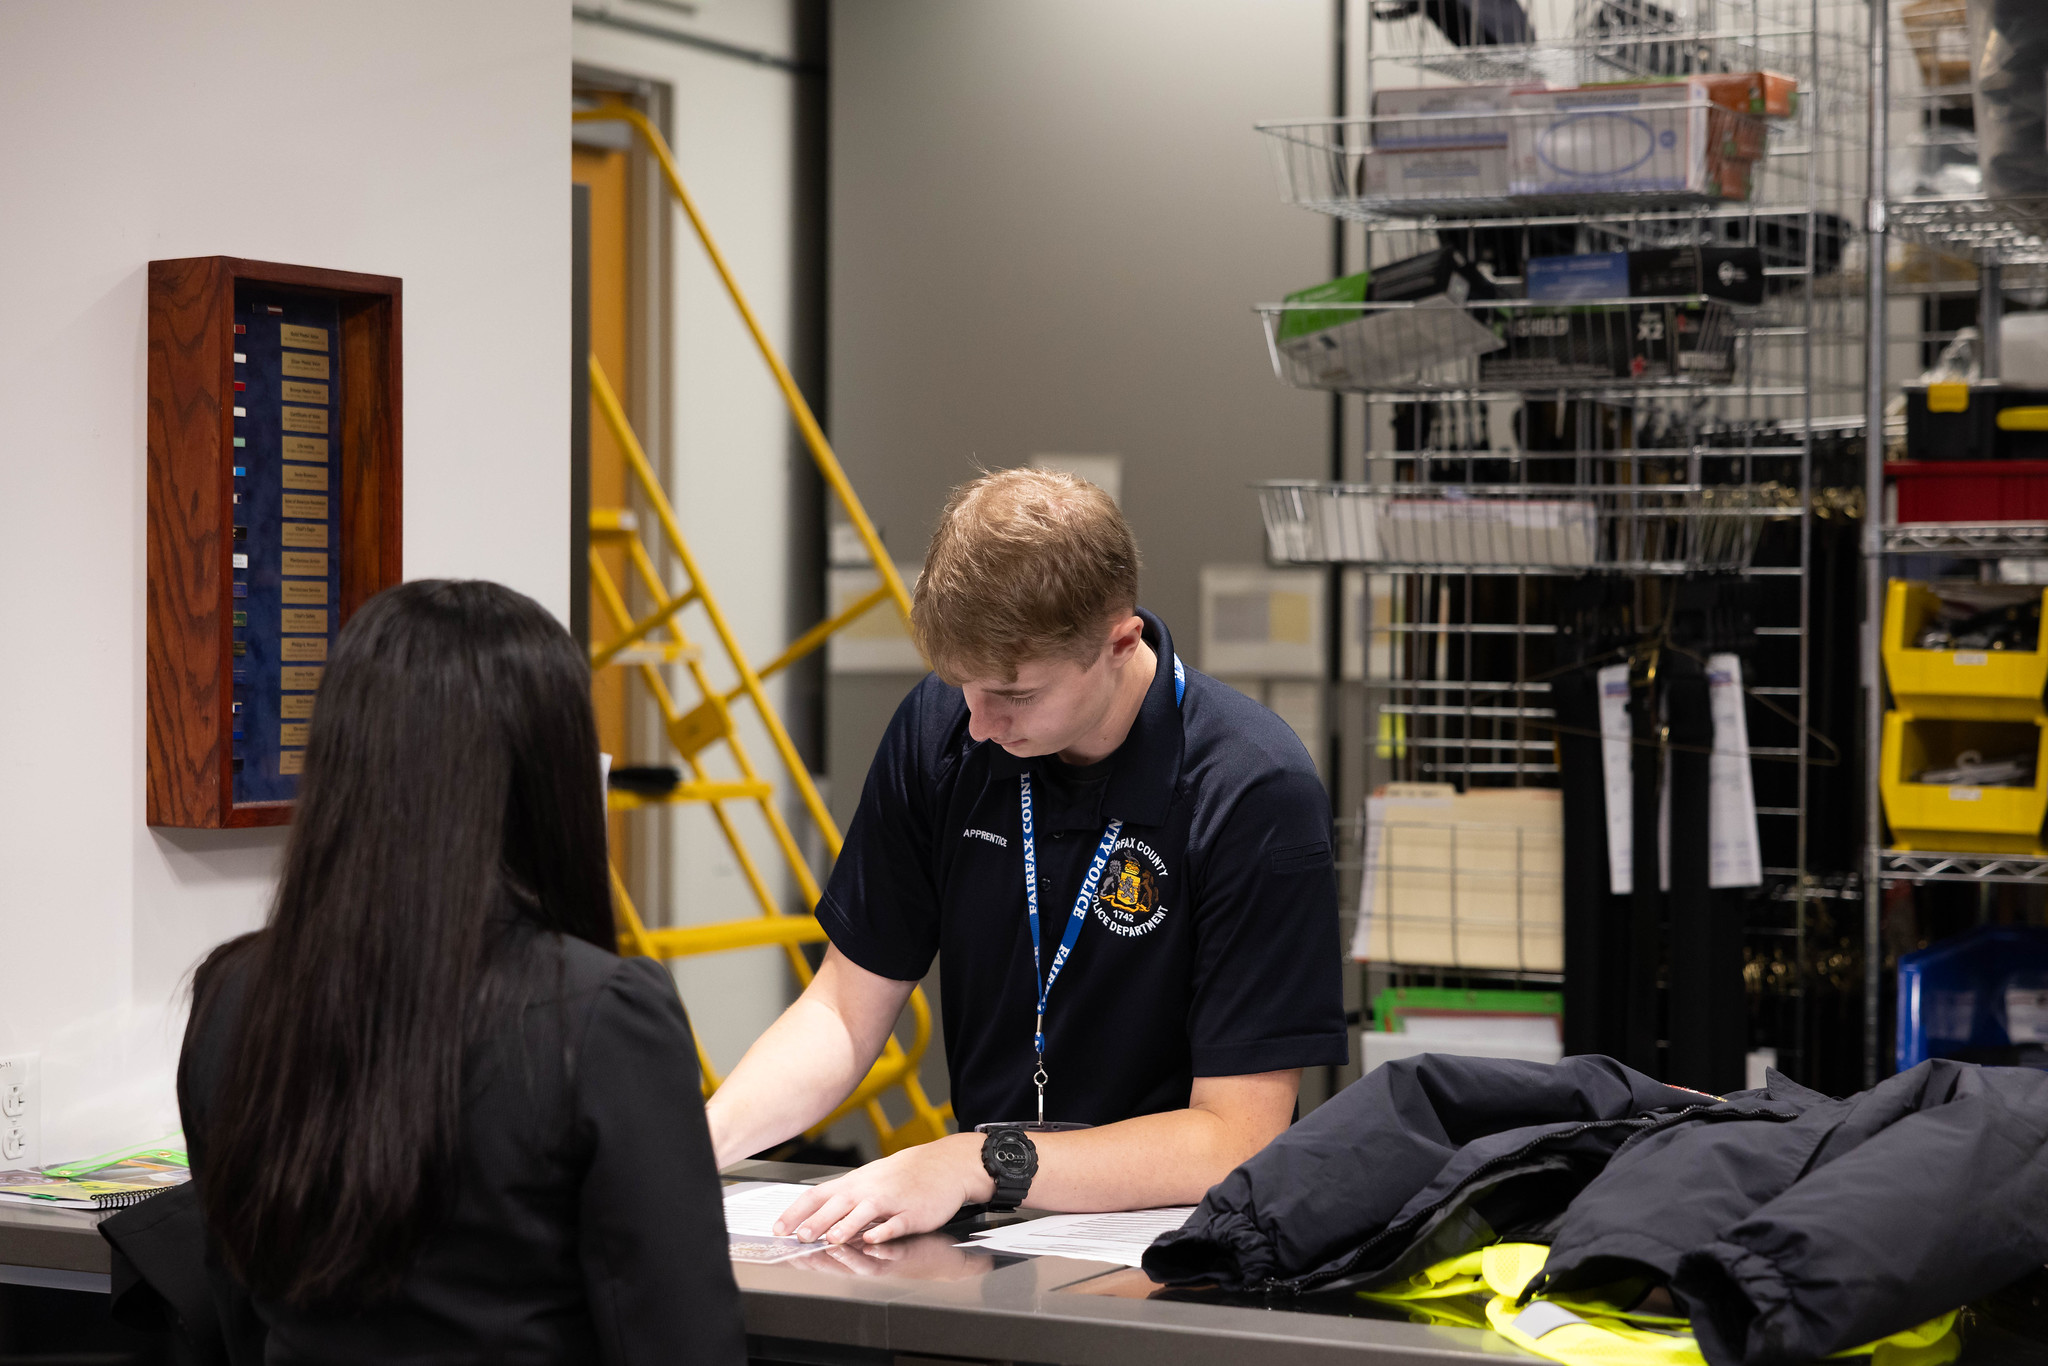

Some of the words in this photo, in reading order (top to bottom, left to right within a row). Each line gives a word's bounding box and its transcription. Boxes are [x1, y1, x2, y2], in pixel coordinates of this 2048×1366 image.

[963, 828, 1008, 848] APPRENTICE
[1136, 841, 1169, 877] COUNTY
[1024, 837, 1037, 916] FAIRFAX
[1073, 855, 1106, 920] POLICE
[1109, 905, 1169, 938] DEPARTMENT
[1113, 909, 1135, 923] 1742
